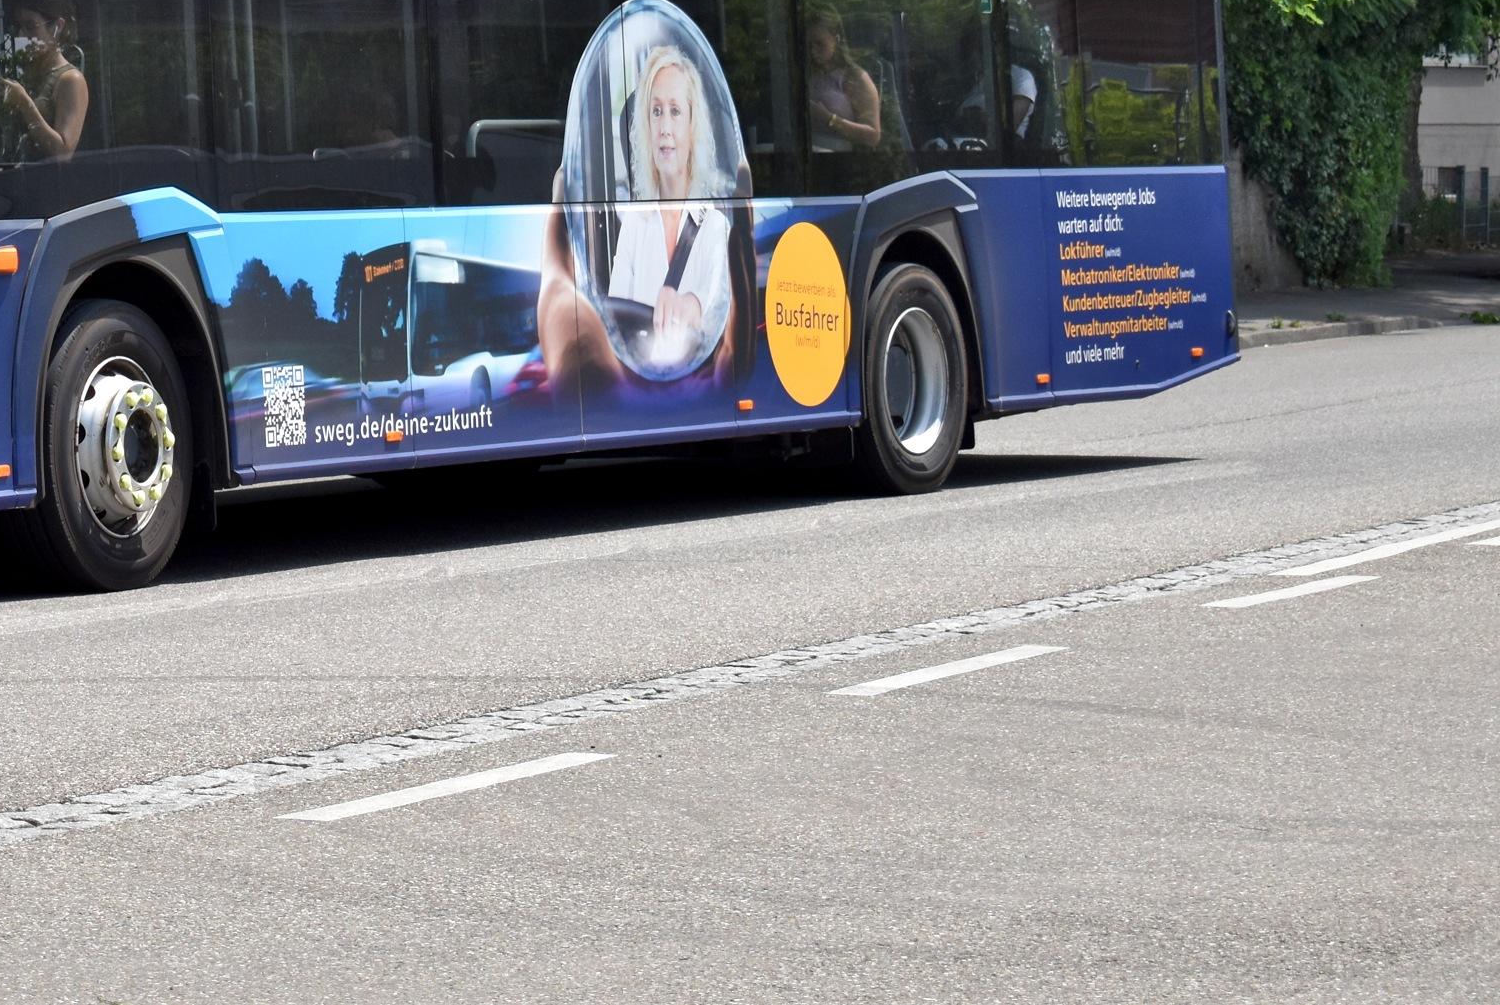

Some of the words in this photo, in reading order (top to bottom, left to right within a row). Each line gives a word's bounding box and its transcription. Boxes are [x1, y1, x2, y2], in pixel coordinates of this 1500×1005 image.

[1056, 189, 1089, 208] Weitere
[1090, 187, 1137, 210] bewegende
[1138, 187, 1156, 206] Jobs
[1058, 218, 1087, 234] warten
[1089, 214, 1103, 233] auf
[1104, 214, 1124, 232] dich:
[1060, 241, 1105, 260] Lokführer
[1061, 262, 1180, 286] Mechatroniker/Elektroniker
[1062, 287, 1191, 313] Kundenbetreuer/Zugbegleiter
[775, 302, 840, 332] Busfahrer
[1064, 313, 1168, 339] Verwaltungsmitarbeiter
[1065, 346, 1082, 364] und
[1083, 344, 1102, 362] viele
[1104, 342, 1125, 361] mehr
[314, 404, 494, 446] sweg.de/deine-zukunft
